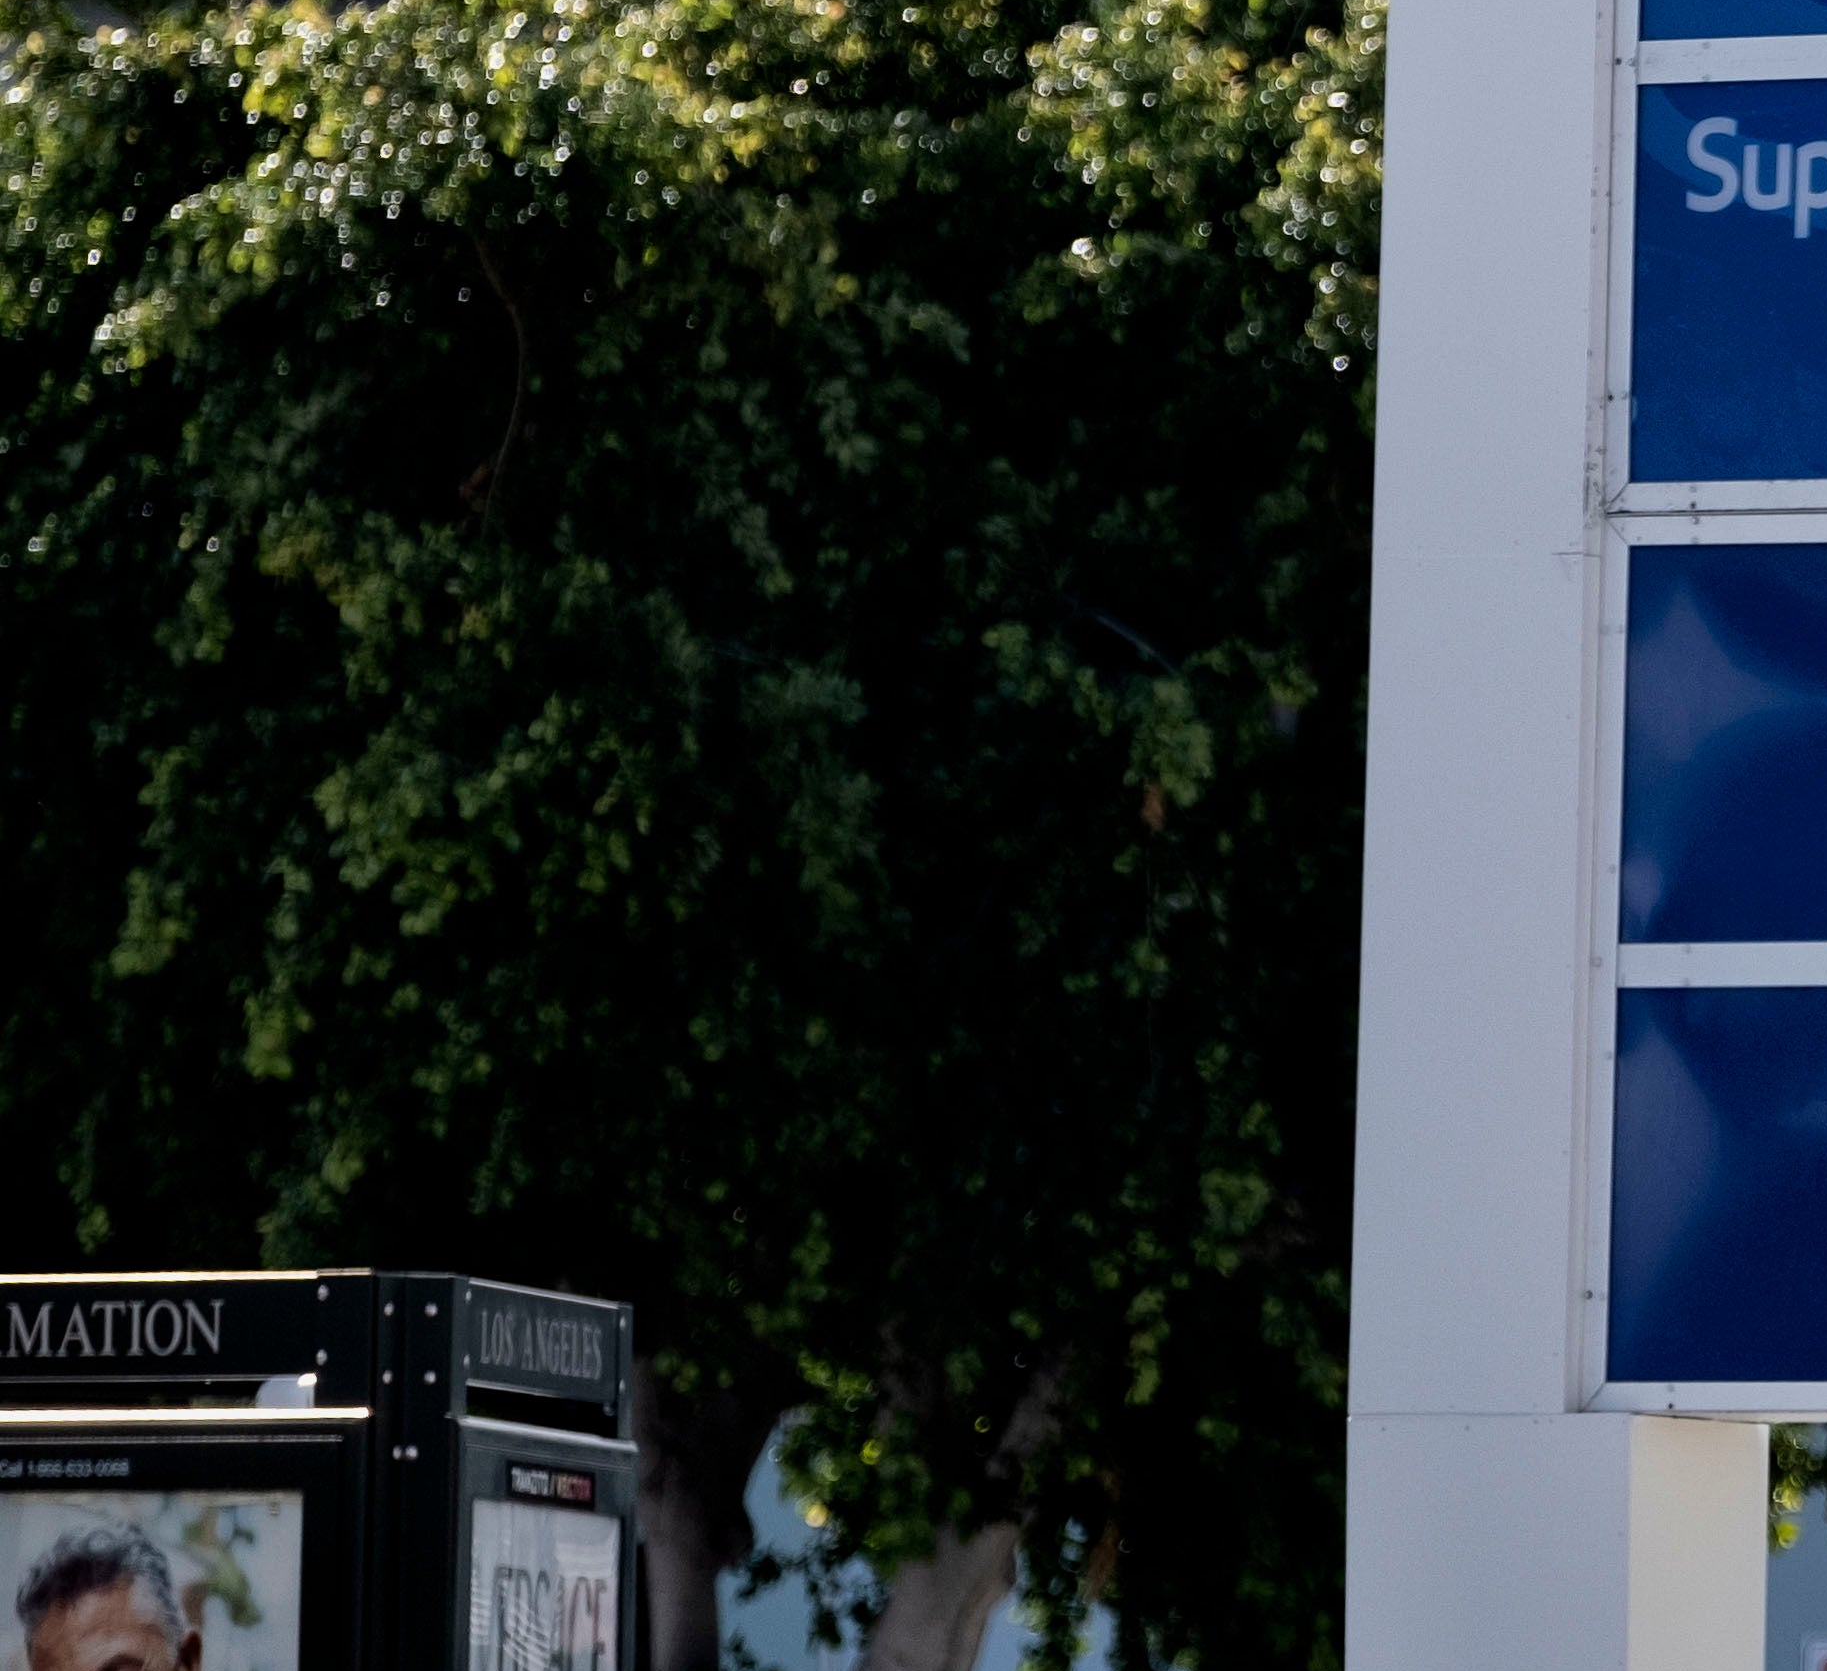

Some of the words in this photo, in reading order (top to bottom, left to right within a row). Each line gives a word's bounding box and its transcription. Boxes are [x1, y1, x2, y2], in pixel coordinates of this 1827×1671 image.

[0, 1298, 225, 1358] MATION
[480, 1309, 514, 1366] LOS
[521, 1315, 602, 1380] ANGELES
